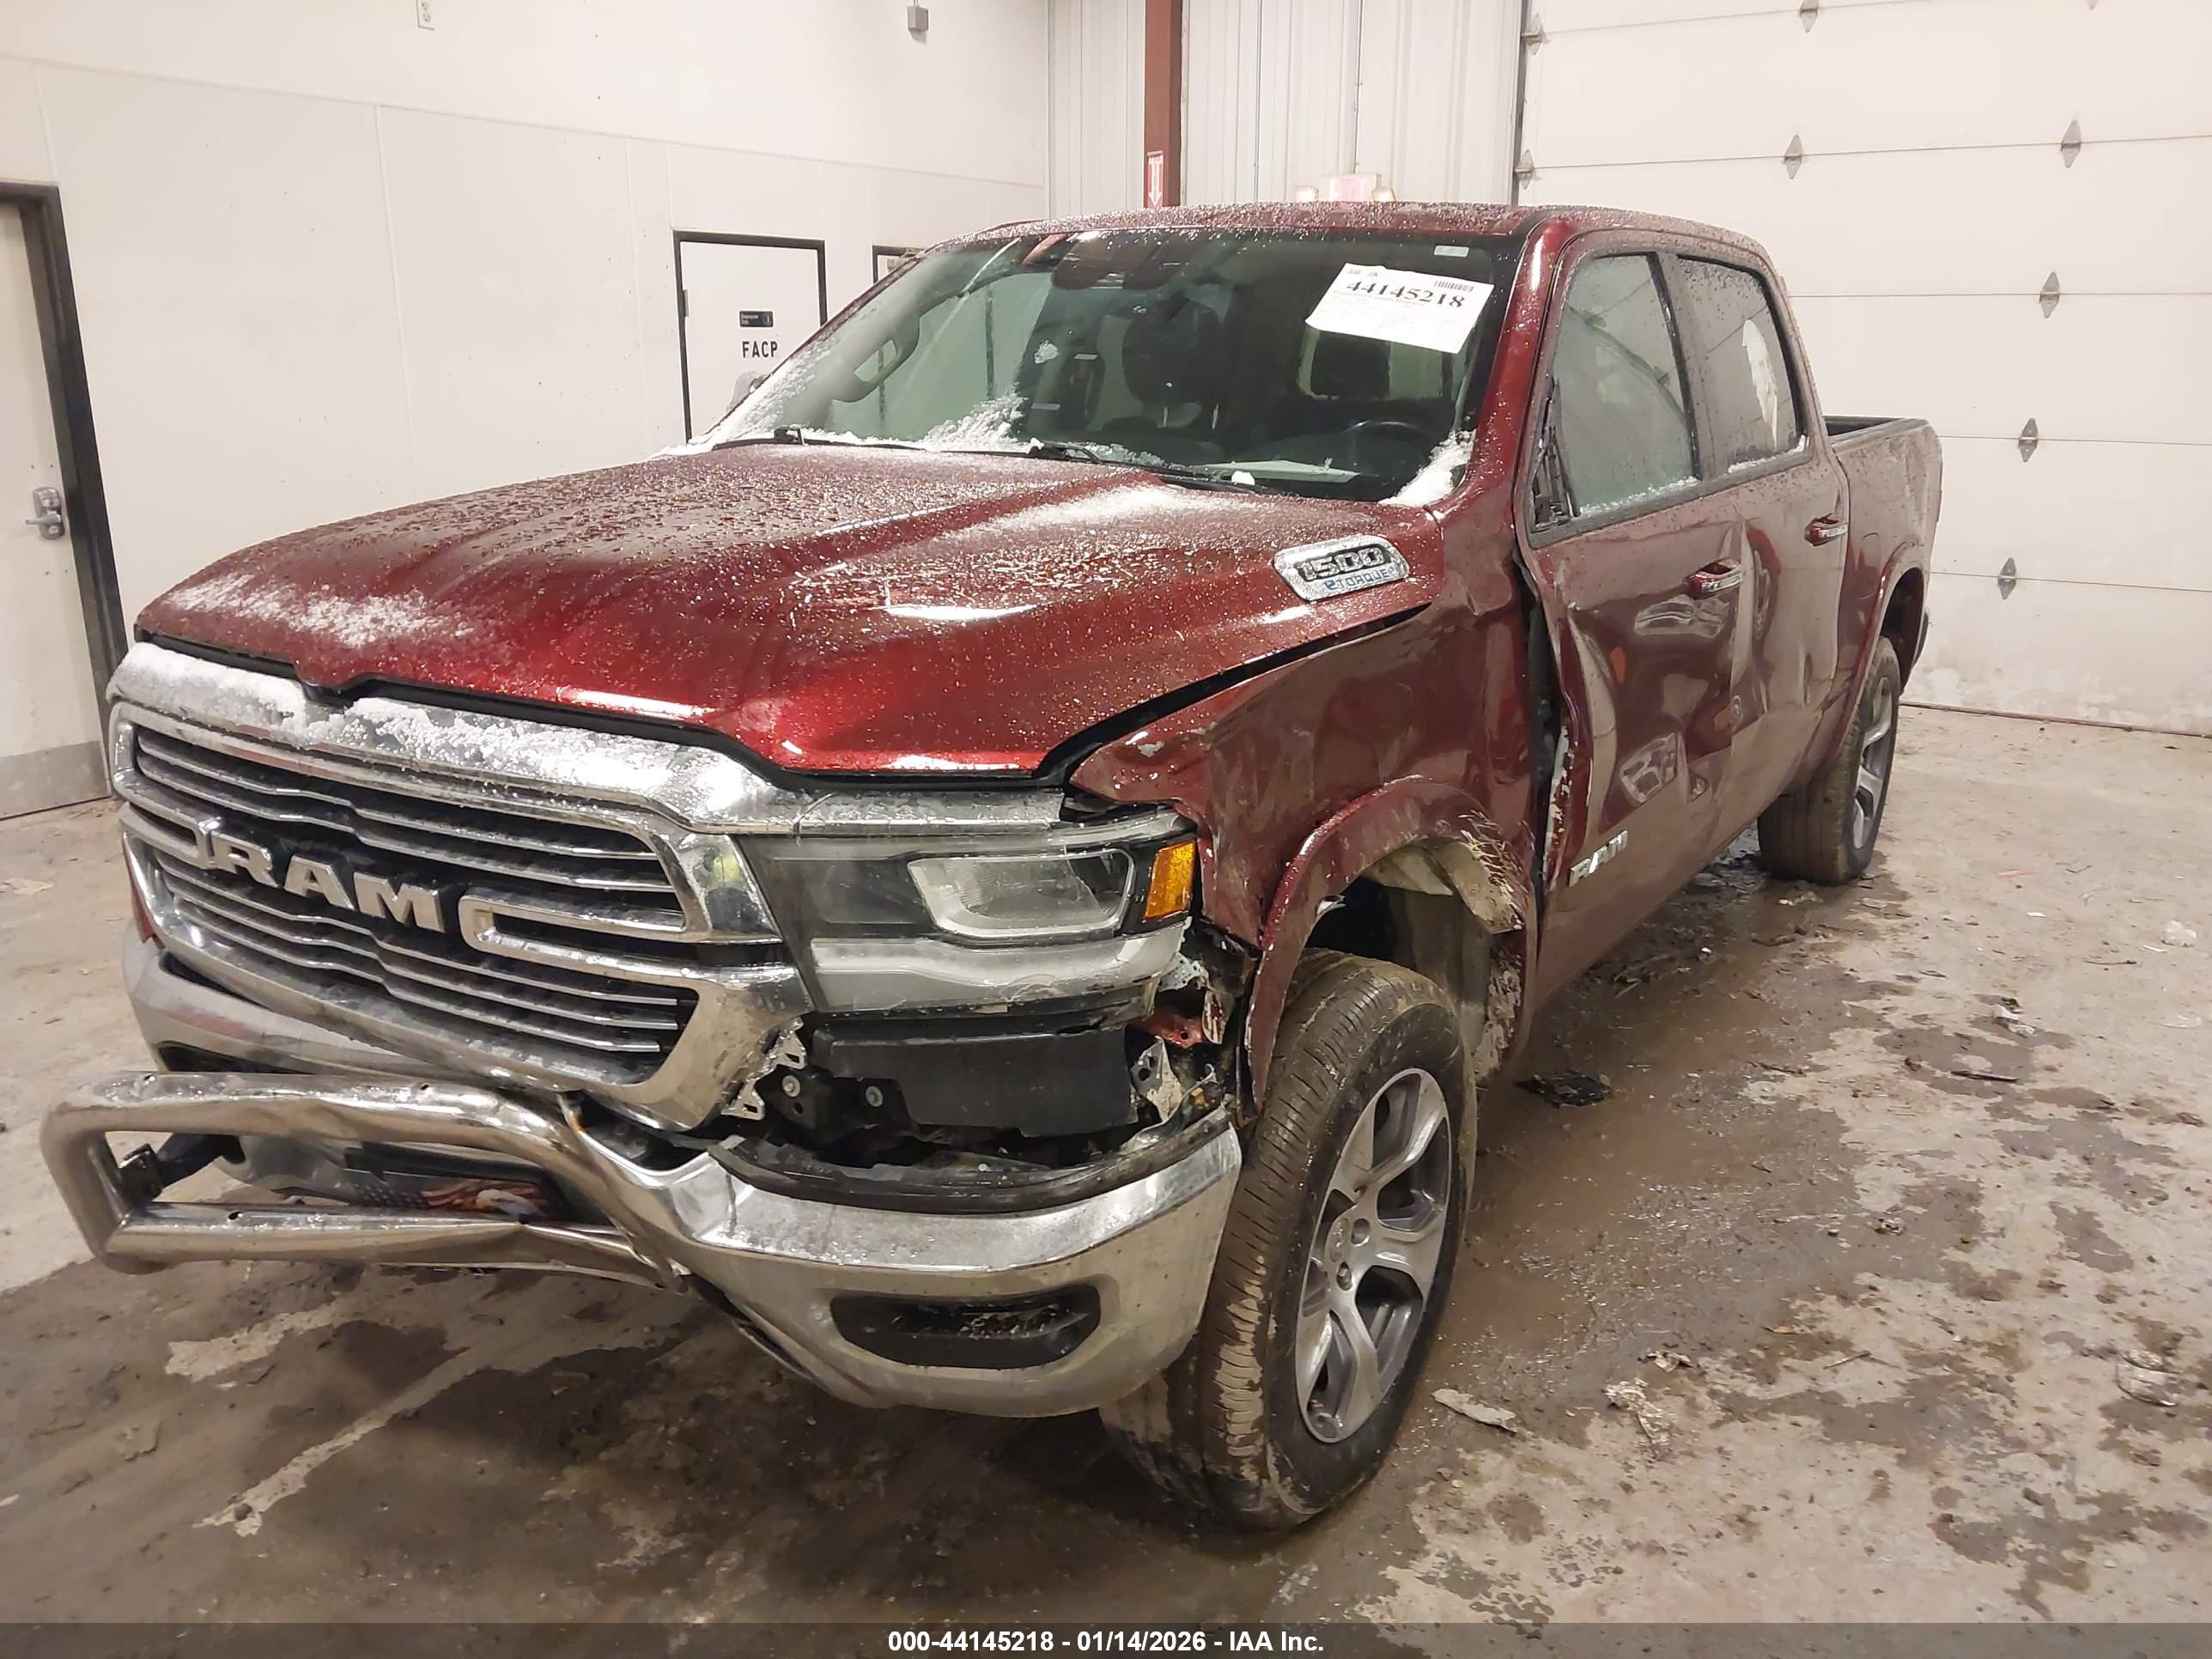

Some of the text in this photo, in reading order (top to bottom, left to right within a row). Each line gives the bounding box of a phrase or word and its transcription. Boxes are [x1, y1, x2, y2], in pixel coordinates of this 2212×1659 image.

[1346, 281, 1466, 308] 44145218
[742, 340, 778, 358] FACP
[1301, 547, 1385, 581] 1500
[211, 830, 447, 933] RAM
